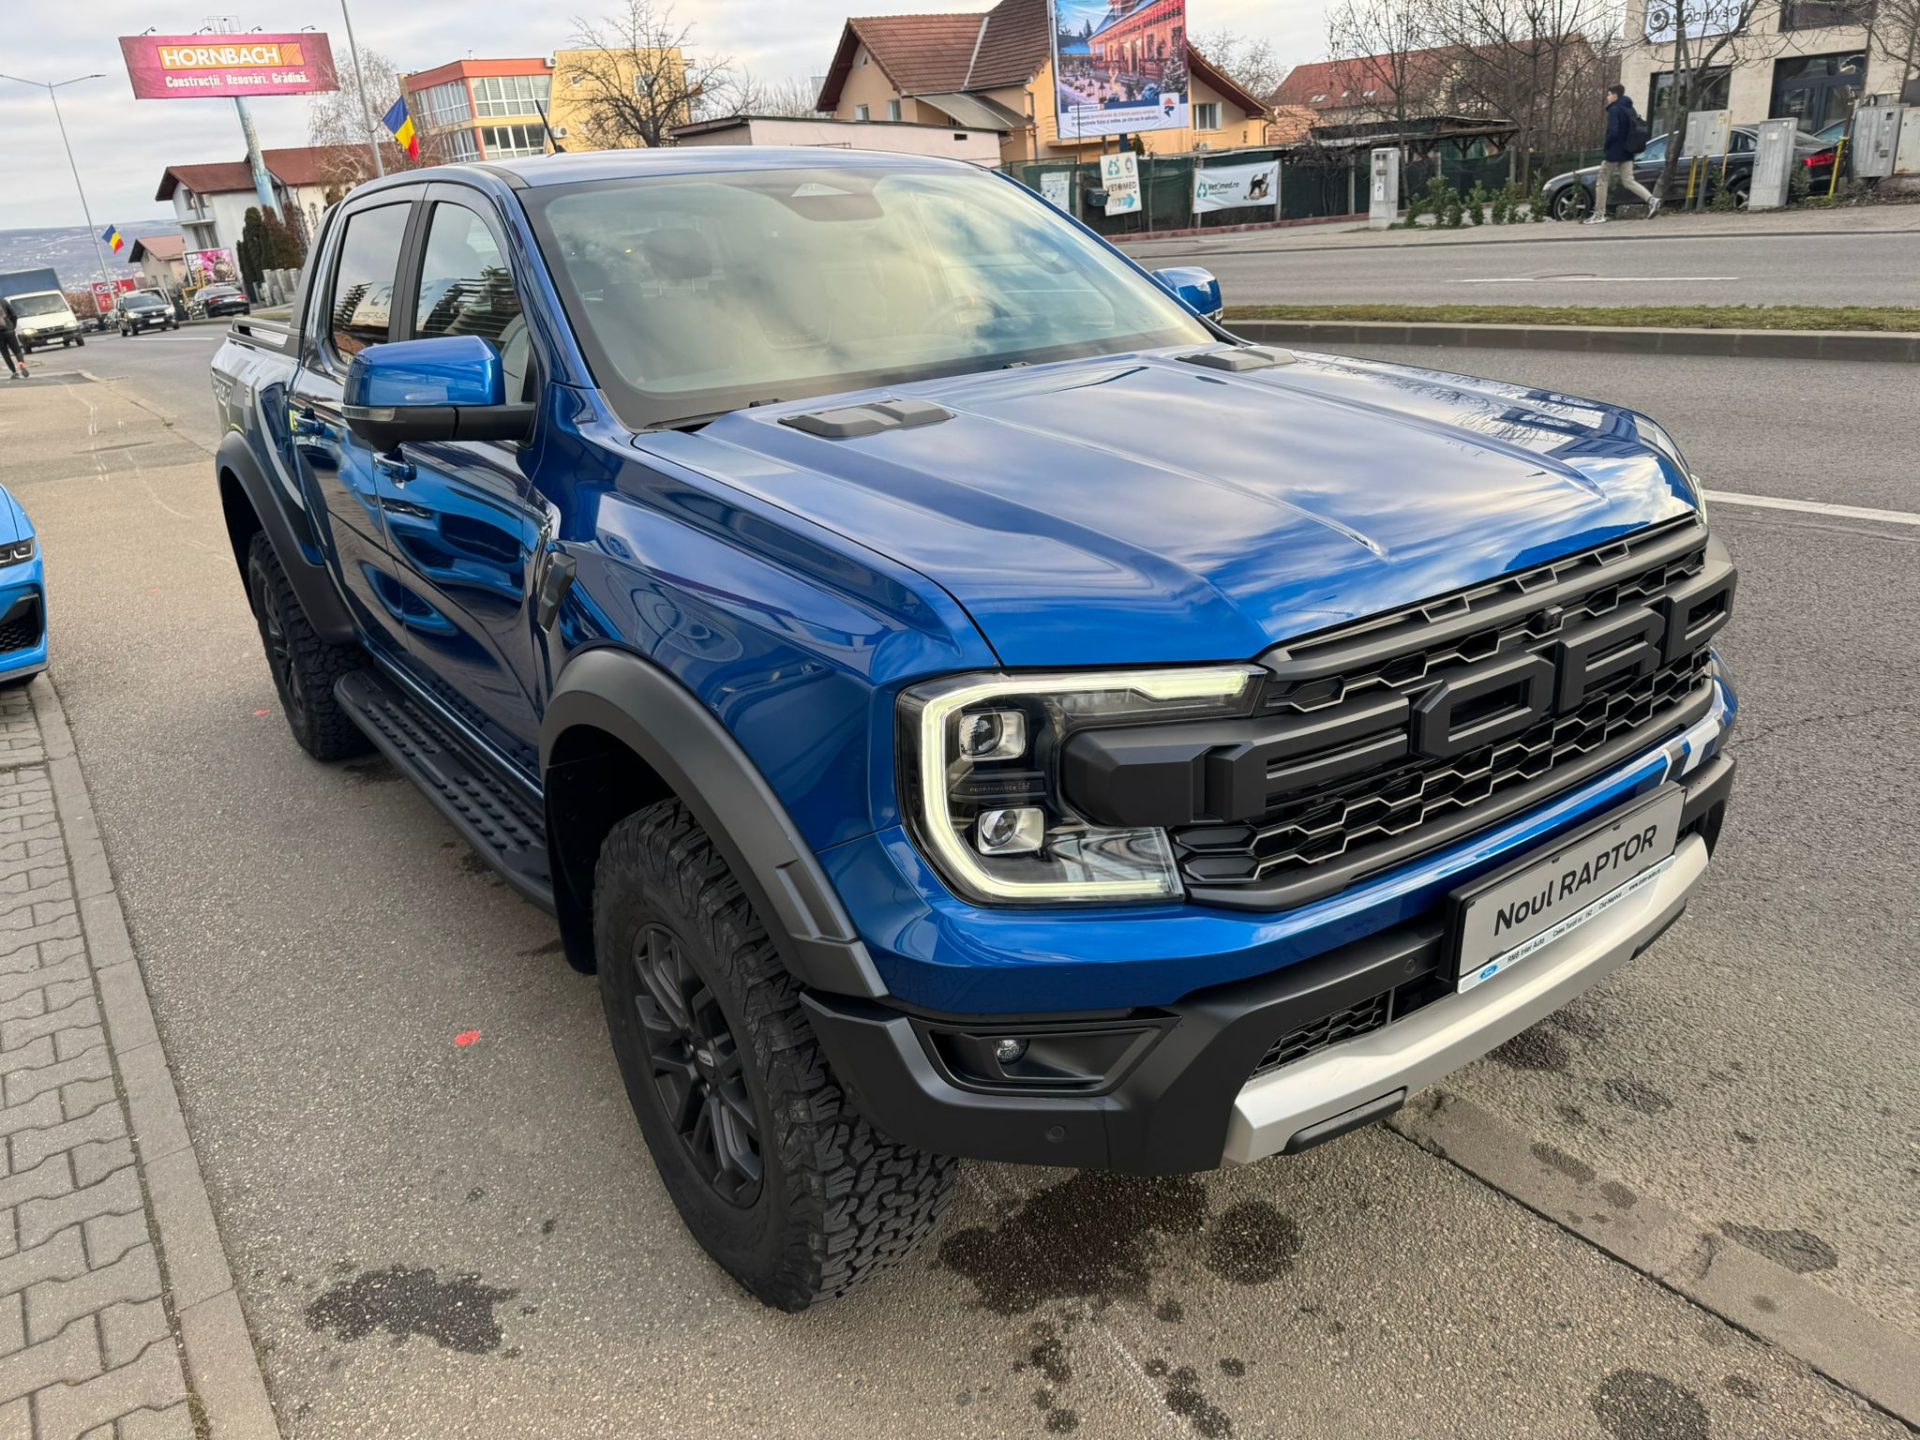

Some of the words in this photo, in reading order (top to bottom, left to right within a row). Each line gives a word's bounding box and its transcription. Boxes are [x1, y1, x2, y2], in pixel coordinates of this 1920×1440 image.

[162, 46, 281, 67] HORNBACH
[226, 73, 269, 85] Renovări.
[1494, 880, 1553, 936] Noul
[1558, 824, 1657, 901] RAPTOR
